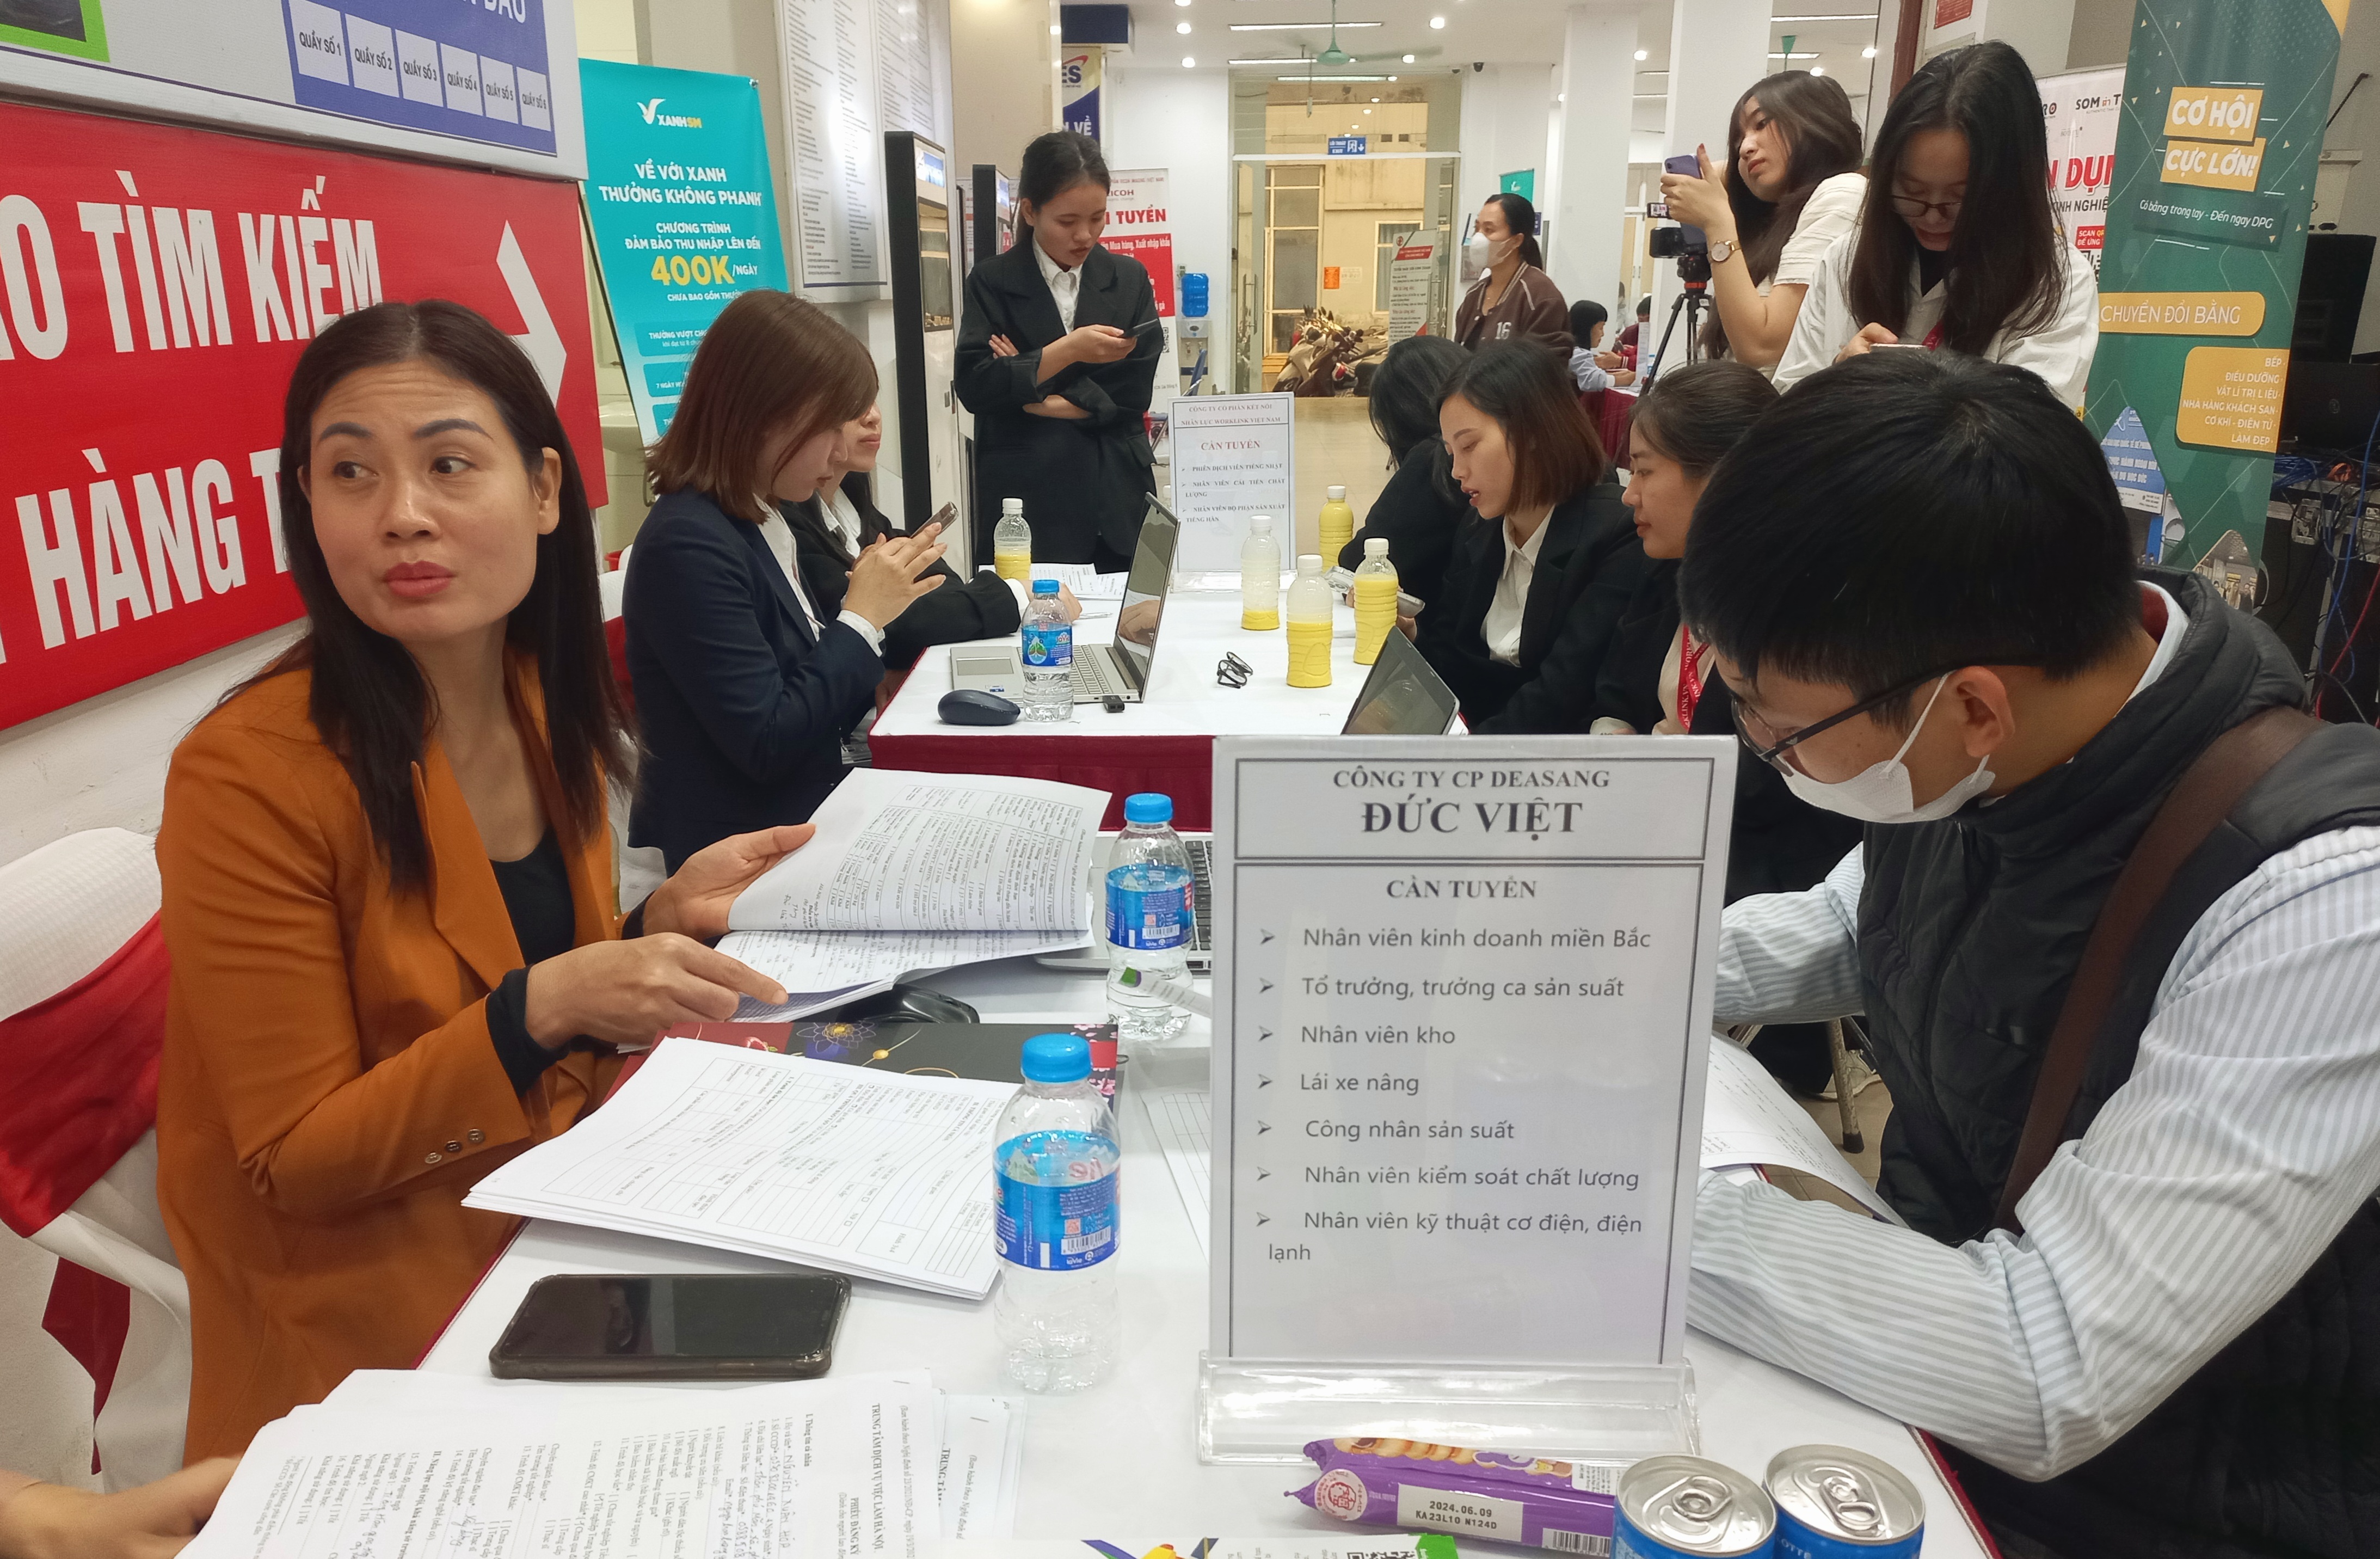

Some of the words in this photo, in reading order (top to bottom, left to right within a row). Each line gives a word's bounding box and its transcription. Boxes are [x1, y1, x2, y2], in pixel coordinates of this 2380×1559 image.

[324, 36, 335, 54] SỐ
[337, 43, 341, 56] 1
[377, 51, 386, 69] SỐ
[388, 58, 392, 70] 2
[423, 63, 432, 79] SỐ
[433, 69, 437, 81] 3
[473, 81, 477, 91] 4
[2075, 96, 2100, 110] SOM
[2172, 97, 2209, 126] CƠ
[2209, 94, 2255, 136] HỘI
[634, 158, 656, 179] VỀ
[657, 161, 684, 180] VỚI
[686, 166, 727, 182] XANH
[2166, 148, 2205, 179] CỰC
[2207, 144, 2259, 177] LỚN!
[599, 181, 663, 203] THƯỞNG
[665, 186, 716, 205] KHÔNG
[1116, 204, 1166, 224] TUYỂN
[2139, 199, 2149, 210] Có
[2149, 200, 2169, 216] bằng
[2170, 205, 2192, 219] trong
[2192, 208, 2204, 221] tay
[2210, 210, 2229, 222] Đến
[2230, 215, 2252, 228] ngay
[2251, 216, 2274, 229] DPG
[656, 222, 699, 234] CHƯƠNG
[700, 220, 731, 234] TRÌNH
[625, 234, 649, 249] ĐẢM
[650, 234, 673, 249] BẢO
[674, 239, 694, 249] THU
[697, 237, 724, 251] NHẬP
[725, 236, 745, 249] LÊN
[0, 195, 69, 361] O
[76, 170, 233, 353] TÌM
[239, 175, 383, 344] KIẾM
[651, 255, 735, 286] 400K
[667, 293, 688, 302] CHƯA
[688, 292, 702, 301] BAO
[2100, 300, 2161, 324] CHUYỂN
[2164, 299, 2190, 324] ĐỔI
[2194, 298, 2242, 325] BẰNG
[1495, 322, 1511, 340] 16
[2265, 356, 2282, 367] BẾP
[2247, 371, 2280, 383] DƯỠNG
[2217, 385, 2231, 398] VẬT
[2233, 385, 2241, 397] LÍ
[2242, 388, 2255, 400] TRỊ
[2182, 397, 2200, 409] NHÀ
[2202, 399, 2225, 411] HÀNG
[2226, 401, 2256, 413] KHÁCH
[2258, 405, 2276, 416] SẠN
[2205, 415, 2217, 425] CƠ
[2218, 416, 2231, 427] KHÍ
[2237, 418, 2260, 431] ĐIỆN
[2262, 418, 2273, 430] TỬ
[2231, 431, 2250, 443] LÀM
[2253, 436, 2270, 447] ĐẸP
[15, 447, 247, 649] HÀNG
[1333, 765, 1404, 789] CÔNG
[1415, 770, 1444, 788] TY
[1452, 771, 1484, 788] CP
[1491, 770, 1610, 789] DEASANG
[1361, 794, 1460, 833] ĐỨC
[1475, 796, 1583, 841] VIỆT
[1448, 875, 1538, 899] TUYỂN
[1305, 928, 1360, 947] Nhân
[1368, 928, 1412, 947] viên
[1421, 928, 1466, 947] kinh
[1474, 928, 1542, 947] doanh
[1551, 926, 1604, 948] miền
[1614, 926, 1651, 948] Bắc
[1301, 974, 1328, 996] Tổ
[1336, 977, 1415, 1000] trưởng,
[1423, 977, 1495, 1001] trưởng
[1503, 981, 1526, 997] ca
[1534, 978, 1571, 997] sản
[1578, 977, 1623, 997] suất
[1301, 1026, 1357, 1045] Nhân
[1366, 1026, 1407, 1045] viên
[1417, 1026, 1455, 1045] kho
[1301, 1072, 1328, 1091] Lái
[1336, 1076, 1359, 1091] xe
[1367, 1073, 1419, 1096] nâng
[1306, 1120, 1360, 1142] Công
[1368, 1120, 1420, 1140] nhân
[1428, 1121, 1462, 1140] sản
[1470, 1119, 1515, 1140] suất
[1306, 1167, 1360, 1184] Nhân
[1367, 1167, 1410, 1185] viên
[1418, 1164, 1467, 1186] kiểm
[1474, 1167, 1518, 1187] soát
[1526, 1166, 1571, 1187] chất
[1578, 1168, 1639, 1191] lượng
[1305, 1212, 1358, 1229] Nhân
[1367, 1212, 1408, 1230] viên
[1416, 1211, 1438, 1234] kỹ
[1446, 1213, 1500, 1233] thuật
[1506, 1214, 1532, 1231] cơ
[1539, 1214, 1590, 1234] điện,
[1597, 1214, 1641, 1235] điện
[1268, 1243, 1311, 1263] lạnh
[871, 1403, 881, 1429] TRUNG
[872, 1431, 884, 1449] TÂM
[870, 1450, 882, 1469] DỊCH
[870, 1471, 882, 1481] VỤ
[873, 1502, 885, 1520] LÀM
[1429, 1500, 1492, 1518] 2024.06.09
[873, 1521, 885, 1533] HÀ
[1415, 1509, 1461, 1526] KA23L10
[1465, 1518, 1498, 1530] N124D
